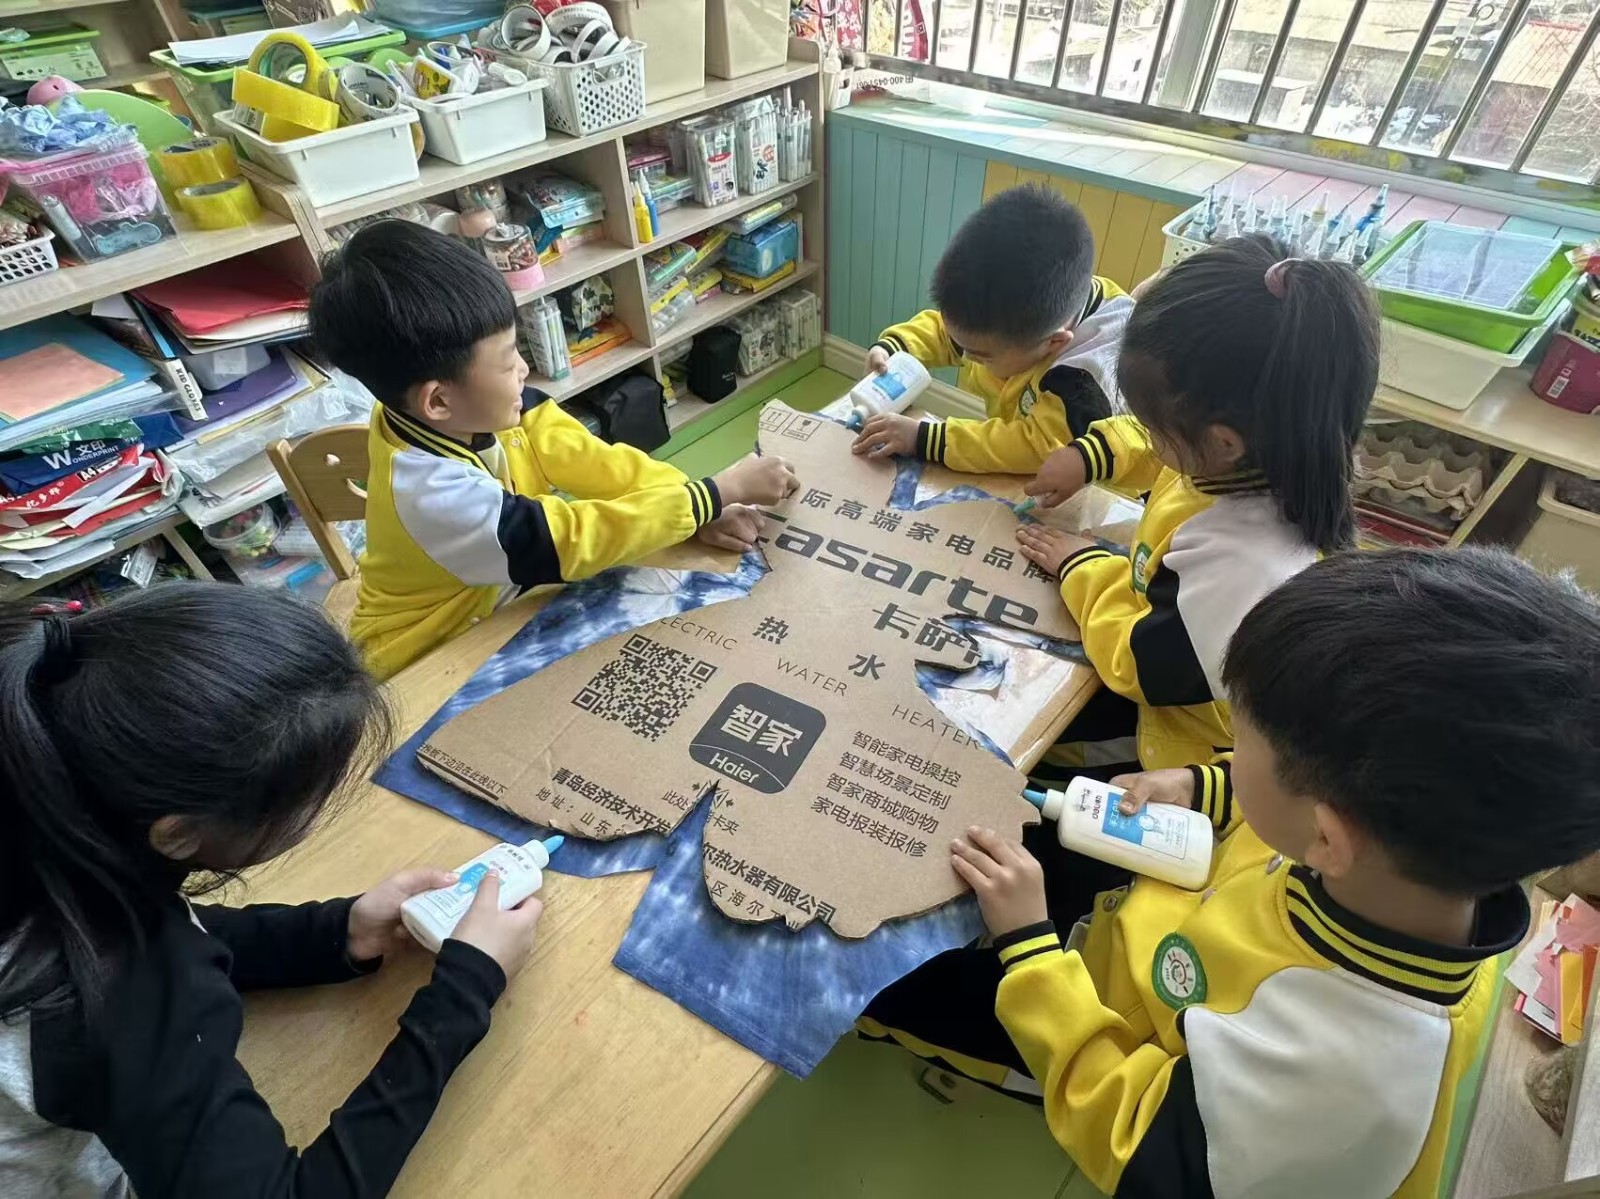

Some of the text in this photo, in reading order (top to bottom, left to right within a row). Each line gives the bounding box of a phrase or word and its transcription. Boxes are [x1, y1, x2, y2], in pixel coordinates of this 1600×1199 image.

[175, 368, 188, 383] KID
[42, 444, 120, 470] WONDERPRINT
[76, 439, 106, 457] 文印
[80, 465, 98, 482] A4
[720, 703, 804, 757] 智家
[776, 657, 849, 698] WATER
[891, 703, 981, 751] HEATER
[709, 752, 760, 784] Haier
[839, 750, 952, 811] 智慧场景定制
[851, 730, 962, 789] 智能家电操控
[551, 766, 672, 835] 青岛经济技术开发
[810, 795, 928, 858] 家电报装报修
[825, 772, 940, 835] 智家商城购物
[703, 841, 837, 923] 尔热水器有限公司
